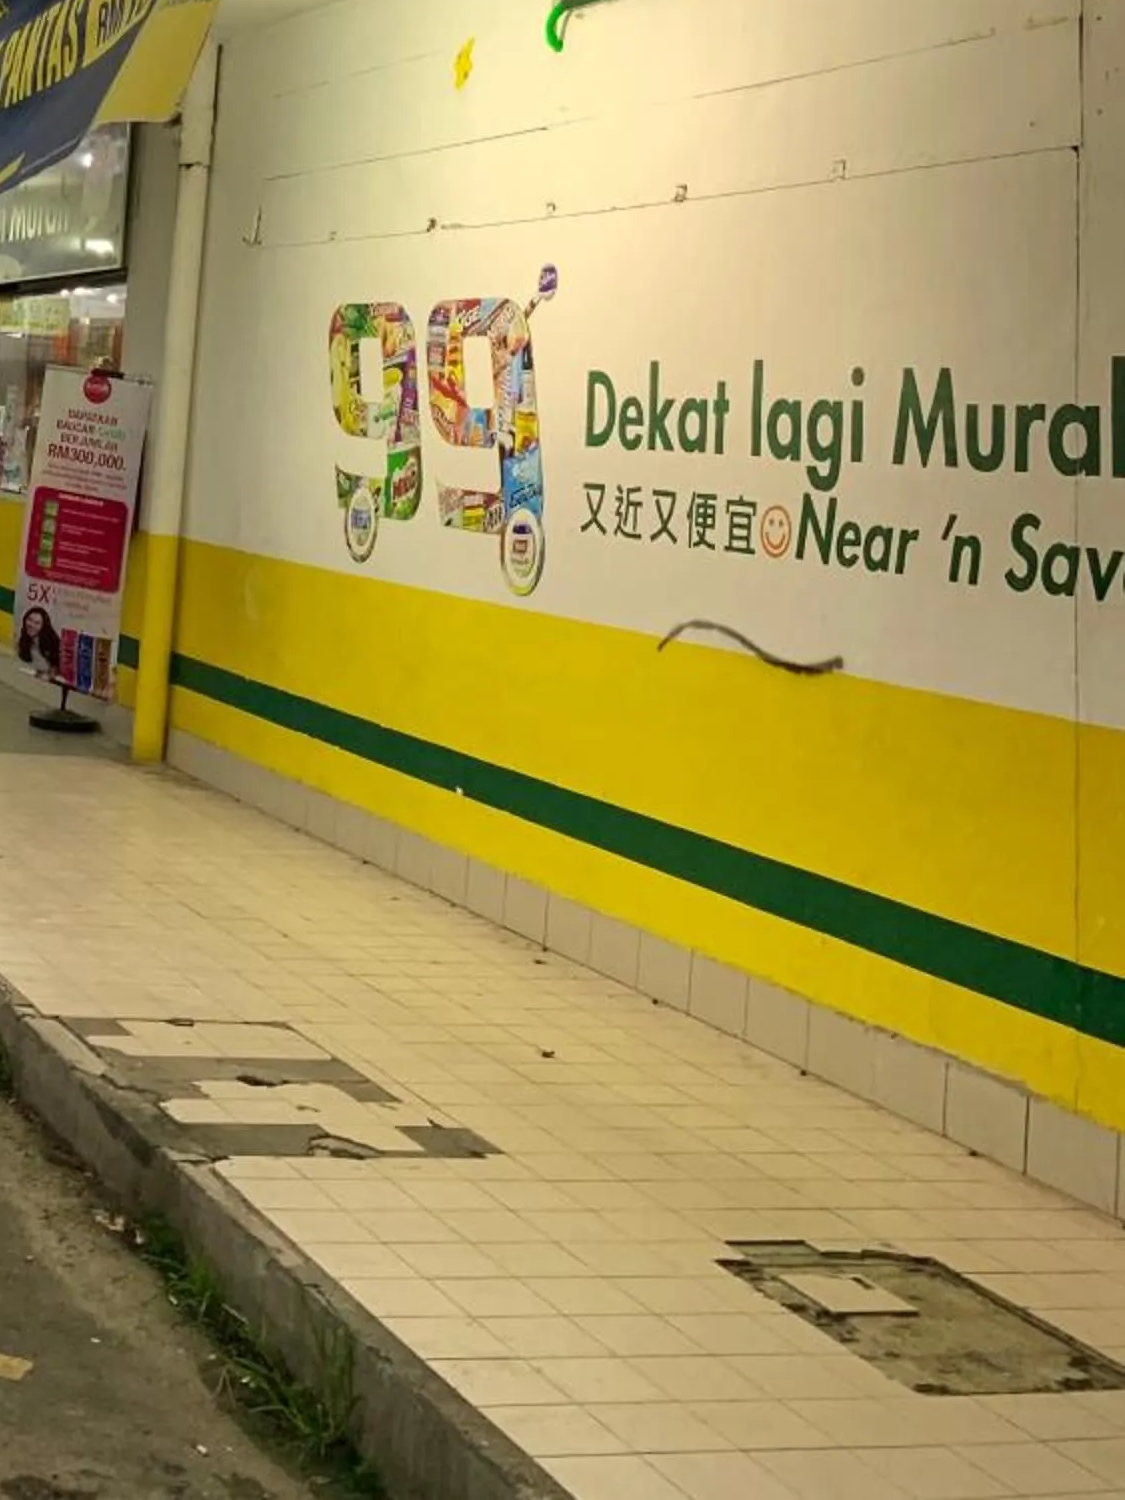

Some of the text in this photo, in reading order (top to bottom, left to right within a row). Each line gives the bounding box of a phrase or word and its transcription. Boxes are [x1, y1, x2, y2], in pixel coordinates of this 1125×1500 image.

[585, 360, 730, 455] Dekat
[751, 359, 865, 493] lagi
[580, 482, 758, 556] 又近又便宜
[795, 492, 920, 575] Near
[1004, 513, 1125, 602] Sav
